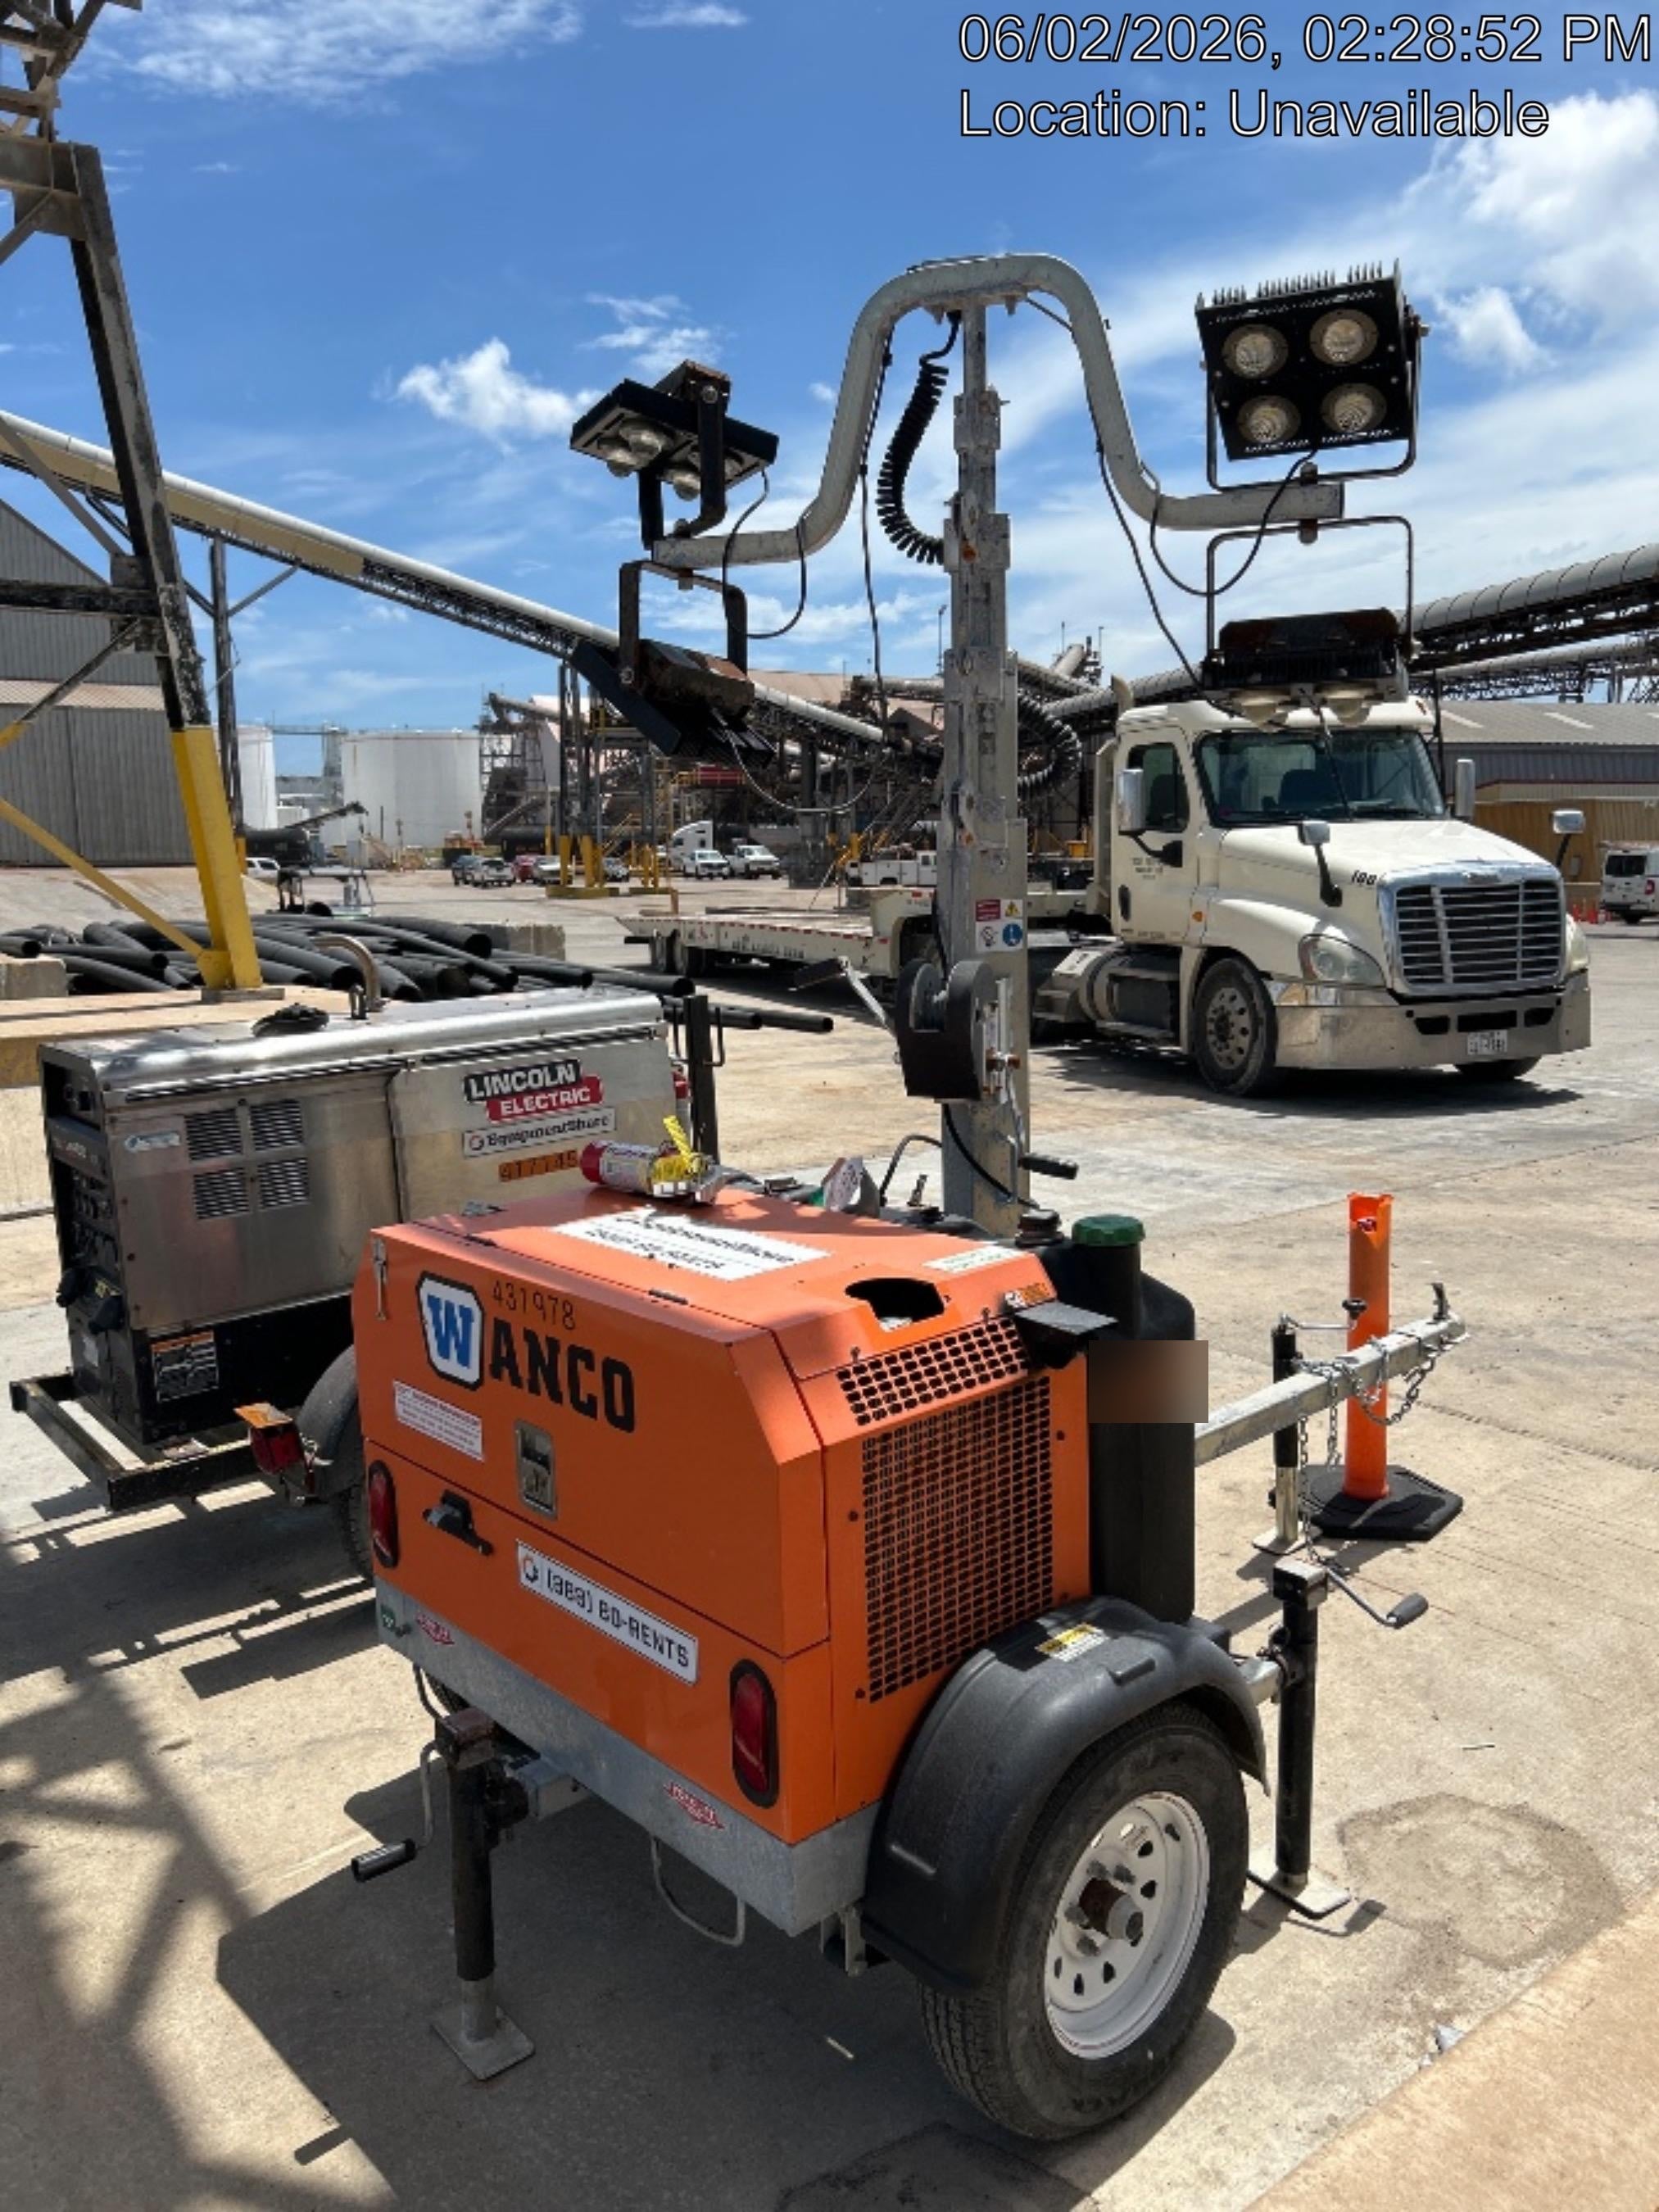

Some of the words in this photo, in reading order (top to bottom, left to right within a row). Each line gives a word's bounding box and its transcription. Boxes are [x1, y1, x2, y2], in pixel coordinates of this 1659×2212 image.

[469, 1063, 576, 1098] LINCOLN
[500, 1087, 590, 1115] ELECTRIC
[492, 1280, 575, 1331] 431978
